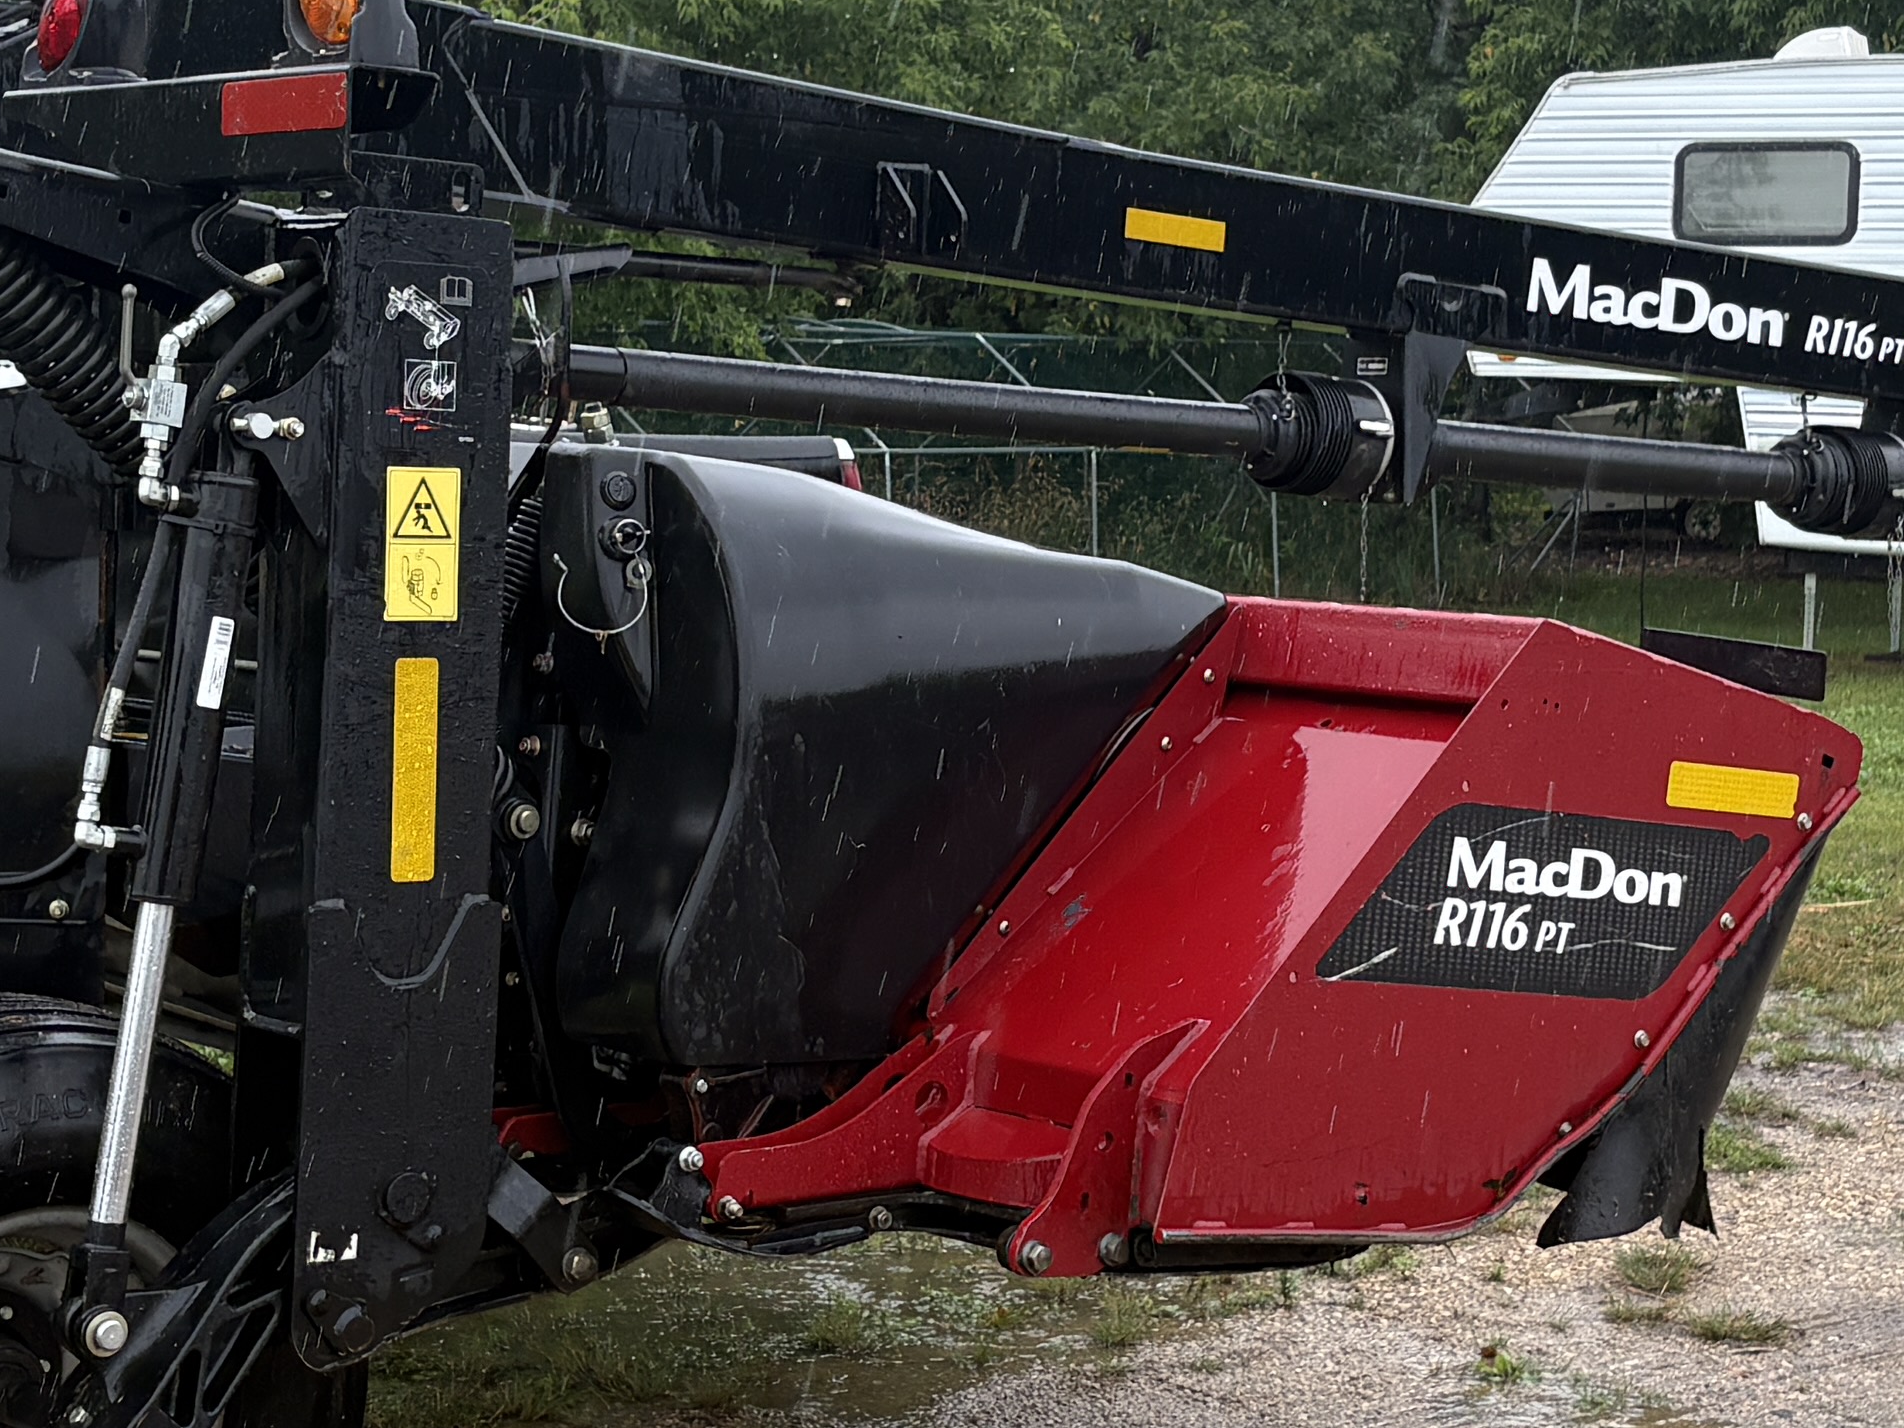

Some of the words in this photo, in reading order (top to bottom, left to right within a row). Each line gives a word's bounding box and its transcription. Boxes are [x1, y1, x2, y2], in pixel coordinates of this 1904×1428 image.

[1526, 257, 1784, 348] MacDon
[1446, 836, 1684, 907] MacDon
[1433, 897, 1533, 952] R116
[1535, 921, 1576, 955] PT
